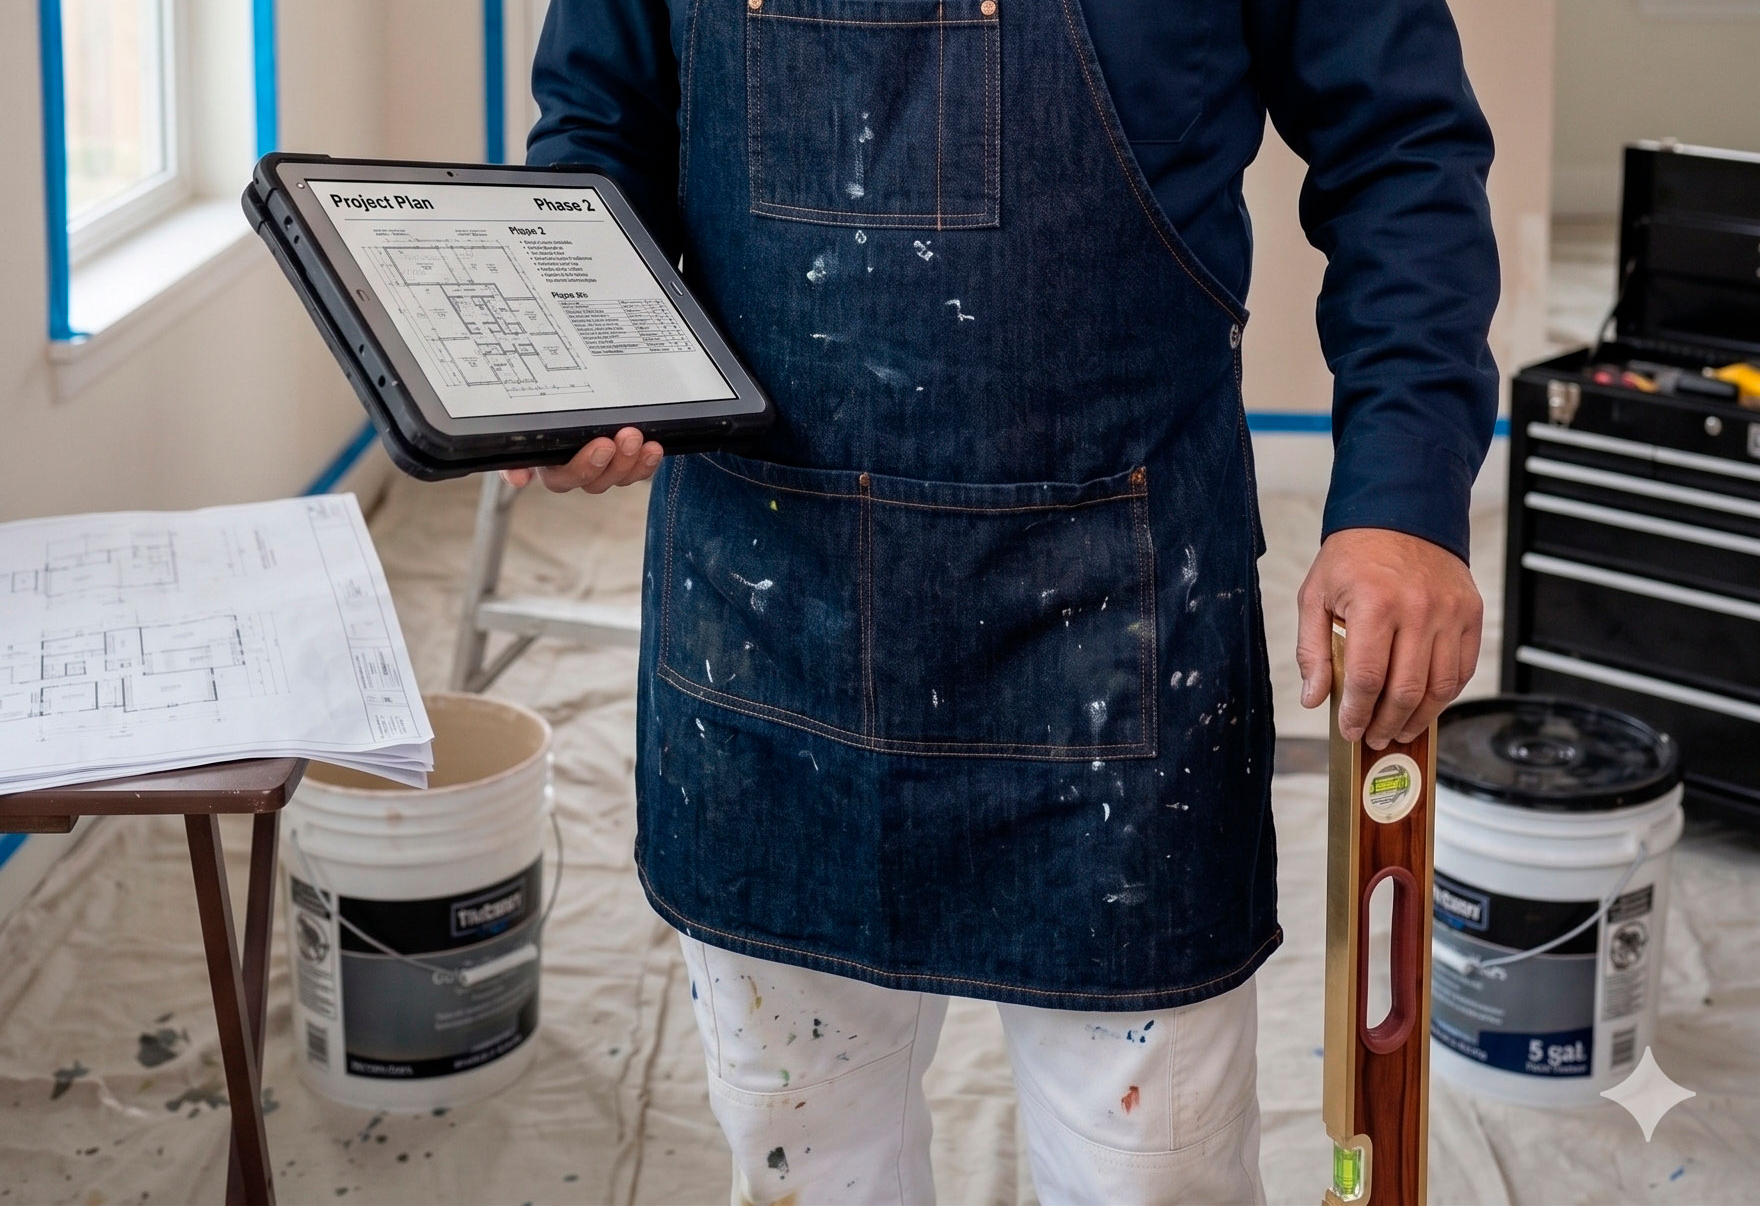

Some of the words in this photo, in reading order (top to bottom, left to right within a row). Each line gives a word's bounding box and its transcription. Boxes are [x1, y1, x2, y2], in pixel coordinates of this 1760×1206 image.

[330, 193, 394, 212] Project
[393, 195, 435, 209] Plan
[533, 197, 582, 212] Phase
[582, 199, 596, 212] 2
[537, 226, 547, 235] 2
[1528, 1039, 1544, 1062] 5
